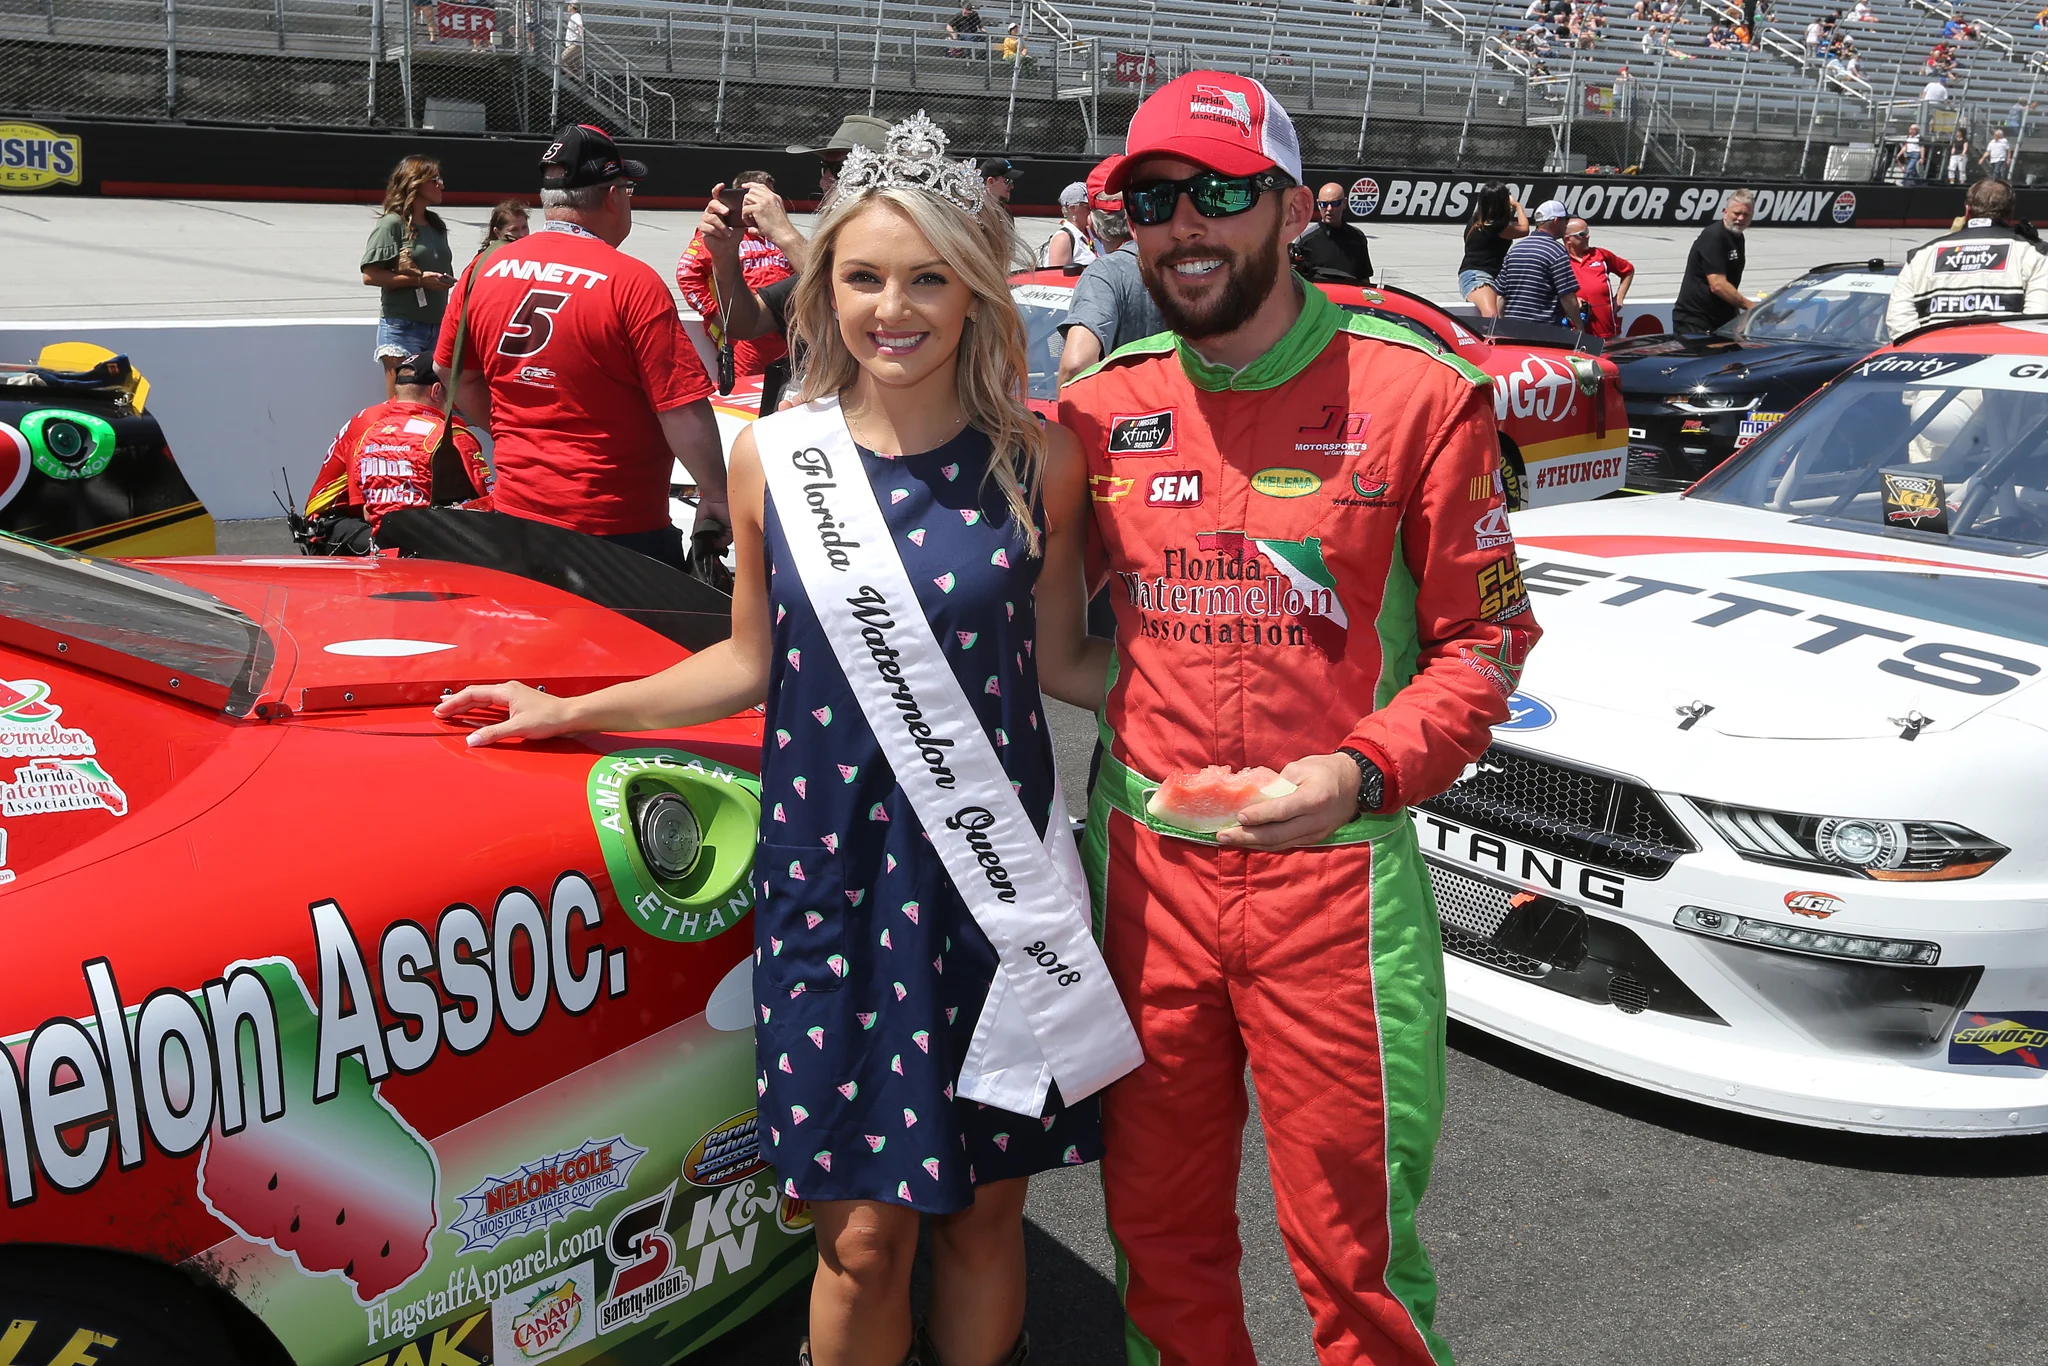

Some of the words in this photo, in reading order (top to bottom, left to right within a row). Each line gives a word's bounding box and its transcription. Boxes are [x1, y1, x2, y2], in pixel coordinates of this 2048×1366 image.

[1190, 101, 1252, 128] Watermelon
[1191, 94, 1224, 106] Florida
[1190, 112, 1238, 127] Association
[0, 138, 76, 175] SH'S
[542, 143, 563, 160] 5
[0, 172, 43, 181] EST
[1551, 184, 1670, 220] MOTOR
[1675, 187, 1834, 222] SPEDWAY
[483, 259, 609, 290] ANNETT
[1944, 251, 1998, 268] xfinity
[1929, 294, 2006, 313] OFFICIAL
[496, 288, 574, 358] 5
[1852, 355, 1958, 377] xfinity
[1120, 427, 1165, 446] xfinity
[1295, 443, 1368, 452] MOTORSPORTS
[37, 455, 110, 478] ETHANOL
[1256, 475, 1314, 489] HELENA
[1536, 456, 1622, 489] #THUNGRY
[1149, 474, 1199, 502] SEM
[1163, 546, 1262, 582] Florida
[1116, 570, 1334, 618] Watermelon
[1140, 611, 1306, 647] Association
[792, 447, 861, 572] Florida
[846, 585, 955, 790] Watermelon
[945, 806, 1017, 904] Queen
[20, 768, 74, 784] Florida
[6, 796, 102, 814] Association
[595, 754, 735, 835] AMERICAN
[1409, 811, 1625, 909] TANG
[1788, 895, 1835, 913] JGL
[1023, 940, 1081, 987] 2018
[1958, 1029, 2048, 1046] SUNOCO
[484, 1143, 614, 1218] NELON-COLE
[480, 1209, 528, 1237] MOISTURE
[530, 1205, 537, 1216] &
[538, 1191, 570, 1212] WATER
[572, 1174, 615, 1198] CONTROL
[364, 1224, 604, 1347] FlagstaffApparel.com
[603, 1275, 682, 1326] safety-kleen
[513, 1291, 583, 1348] CANADA
[535, 1312, 568, 1348] DRY
